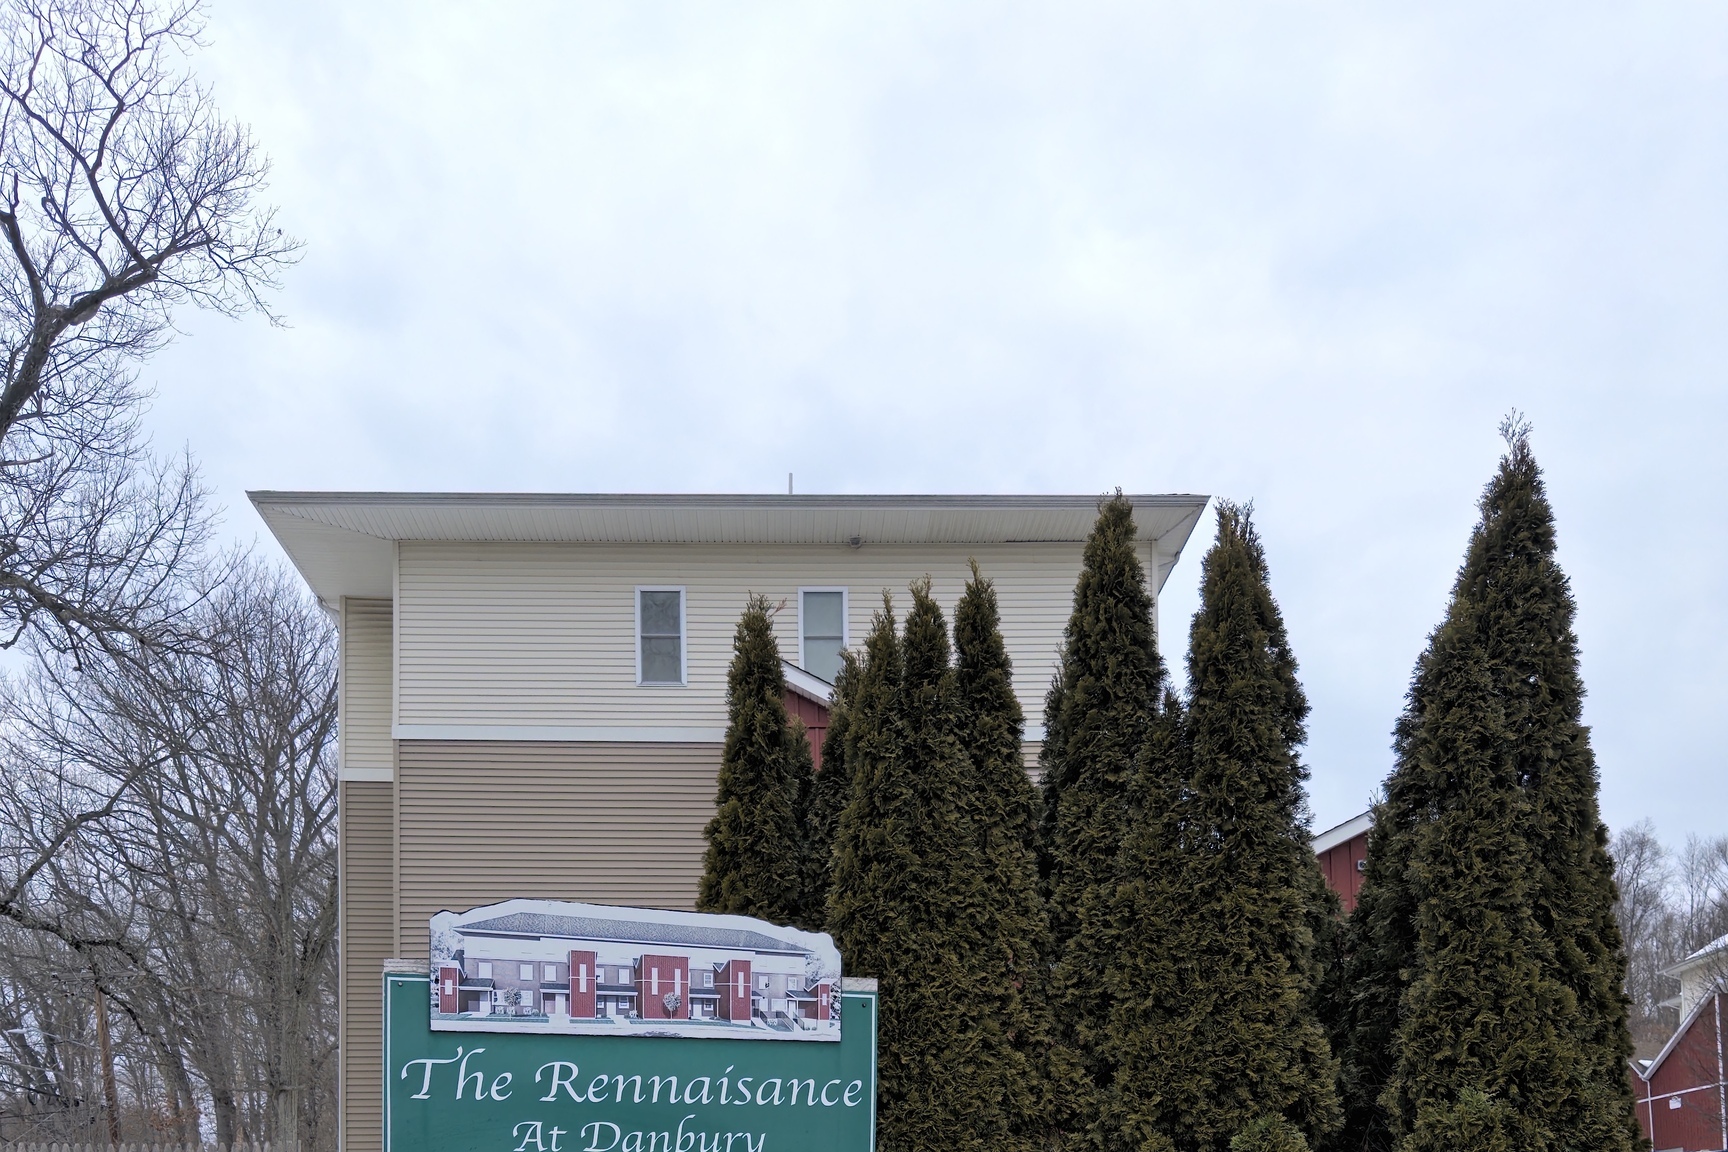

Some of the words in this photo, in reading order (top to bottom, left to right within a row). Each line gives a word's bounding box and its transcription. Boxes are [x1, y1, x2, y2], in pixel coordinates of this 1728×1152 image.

[400, 1046, 513, 1101] The
[535, 1061, 863, 1107] Rennaisance
[512, 1121, 567, 1152] At
